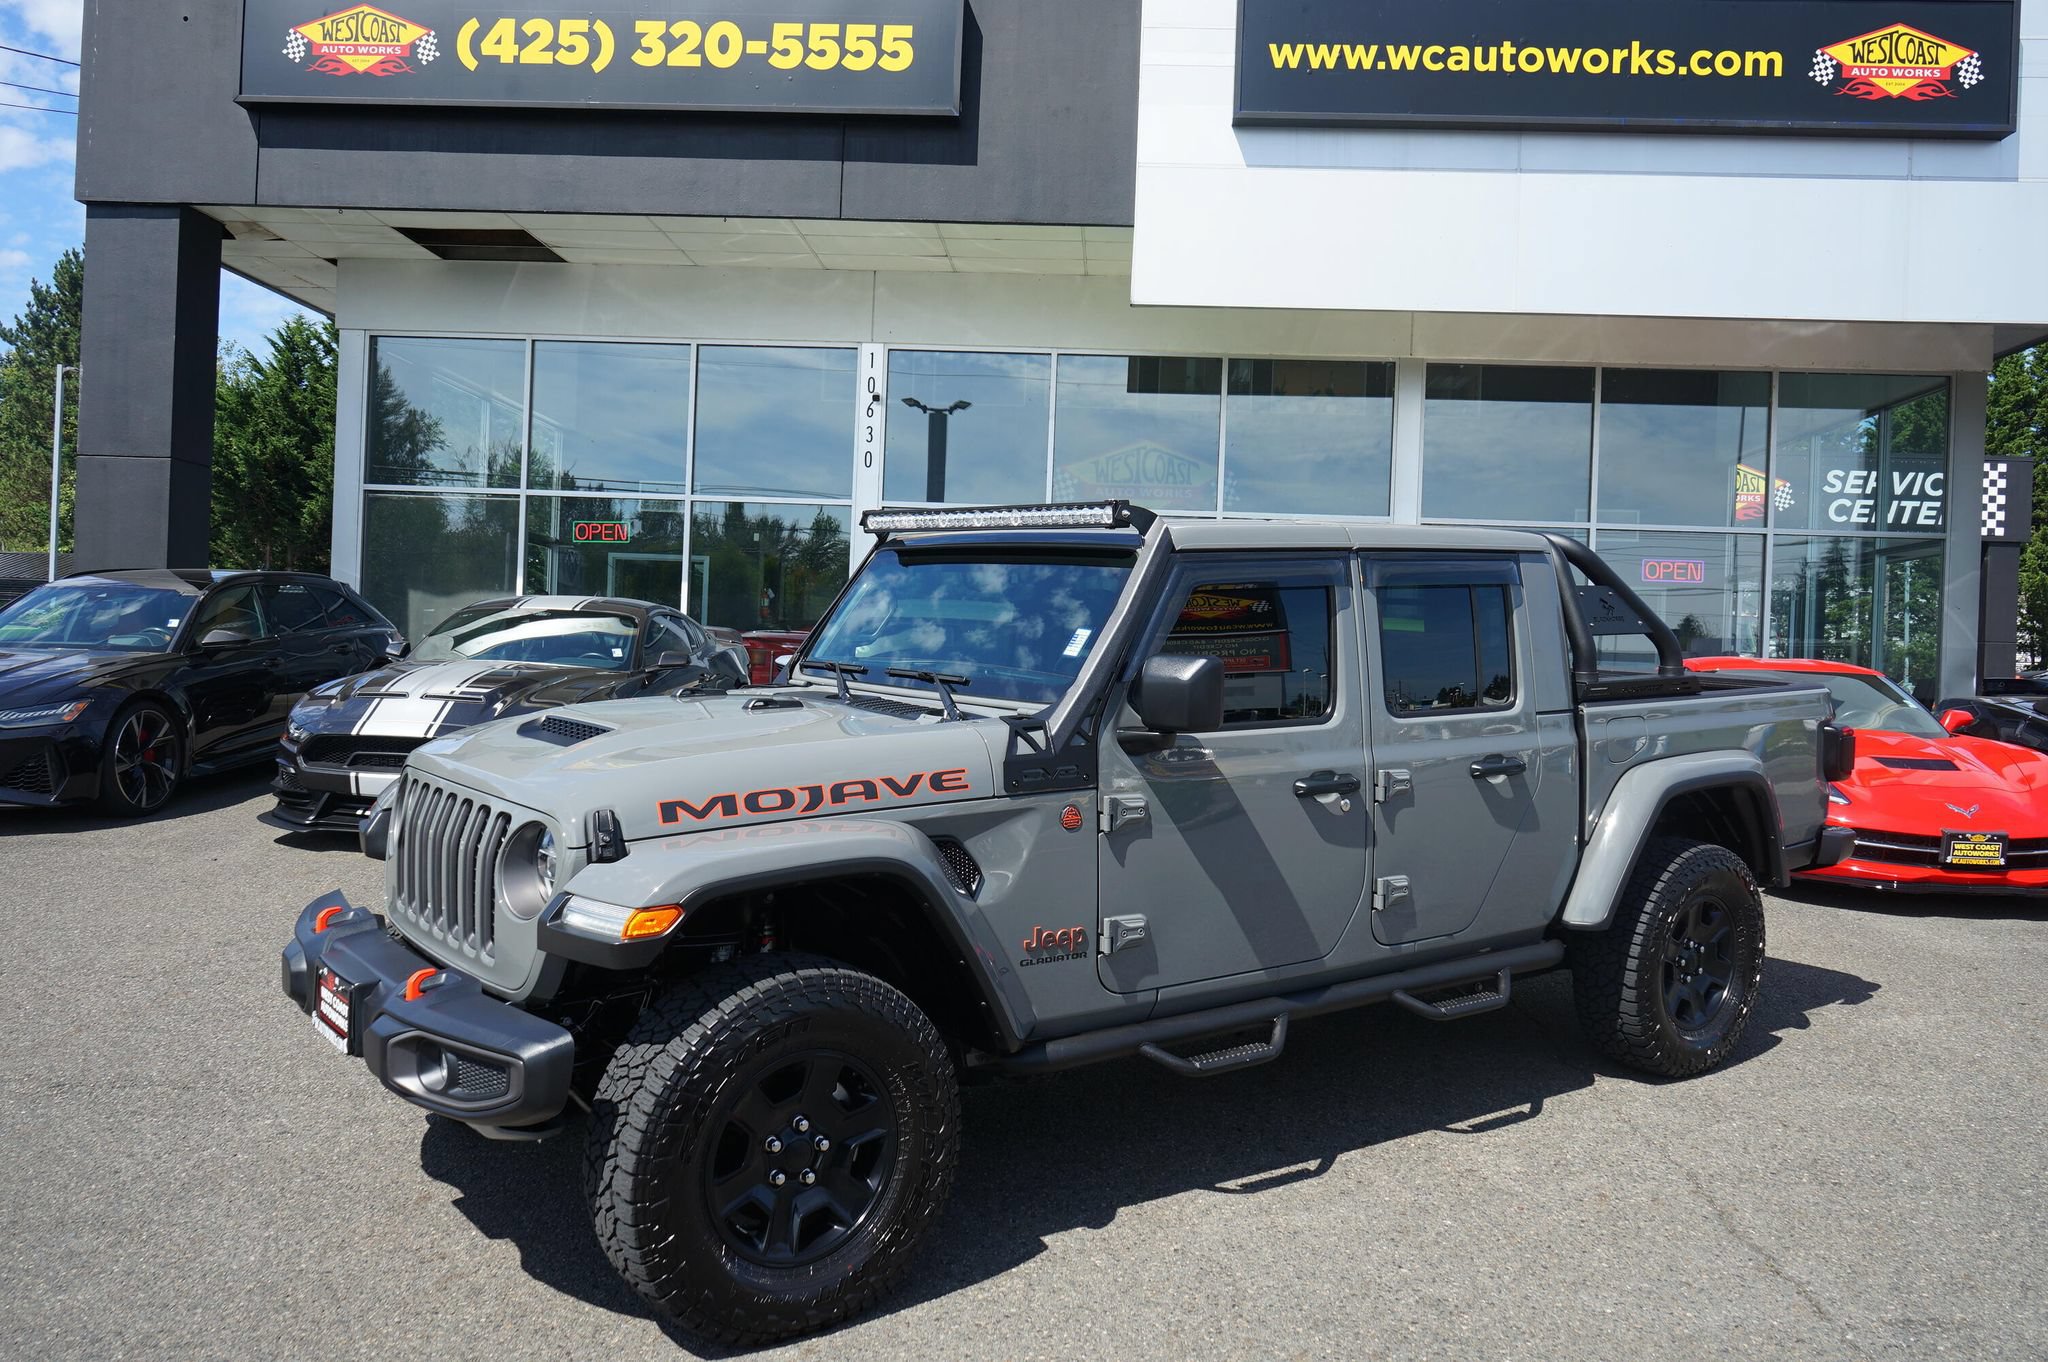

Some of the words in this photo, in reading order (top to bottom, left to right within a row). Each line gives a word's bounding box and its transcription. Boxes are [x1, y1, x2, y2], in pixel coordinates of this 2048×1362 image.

[321, 45, 355, 54] AUTO
[357, 46, 402, 55] WORKS
[456, 16, 615, 73] (425)
[632, 20, 914, 72] 320-5555
[1268, 41, 1783, 78] www.wcautoworks.com
[1851, 67, 1888, 77] AUTO
[1892, 68, 1941, 78] WORKS
[1094, 487, 1138, 497] AUTO
[1141, 488, 1193, 498] WORKS
[1822, 469, 1944, 497] SEVIC
[1828, 498, 1943, 525] CETE
[575, 523, 628, 541] OPEN
[1645, 561, 1701, 581] OPEN
[657, 767, 970, 826] MOJAVE
[1023, 925, 1086, 951] Jeep
[1019, 951, 1088, 967] GLADIATOR
